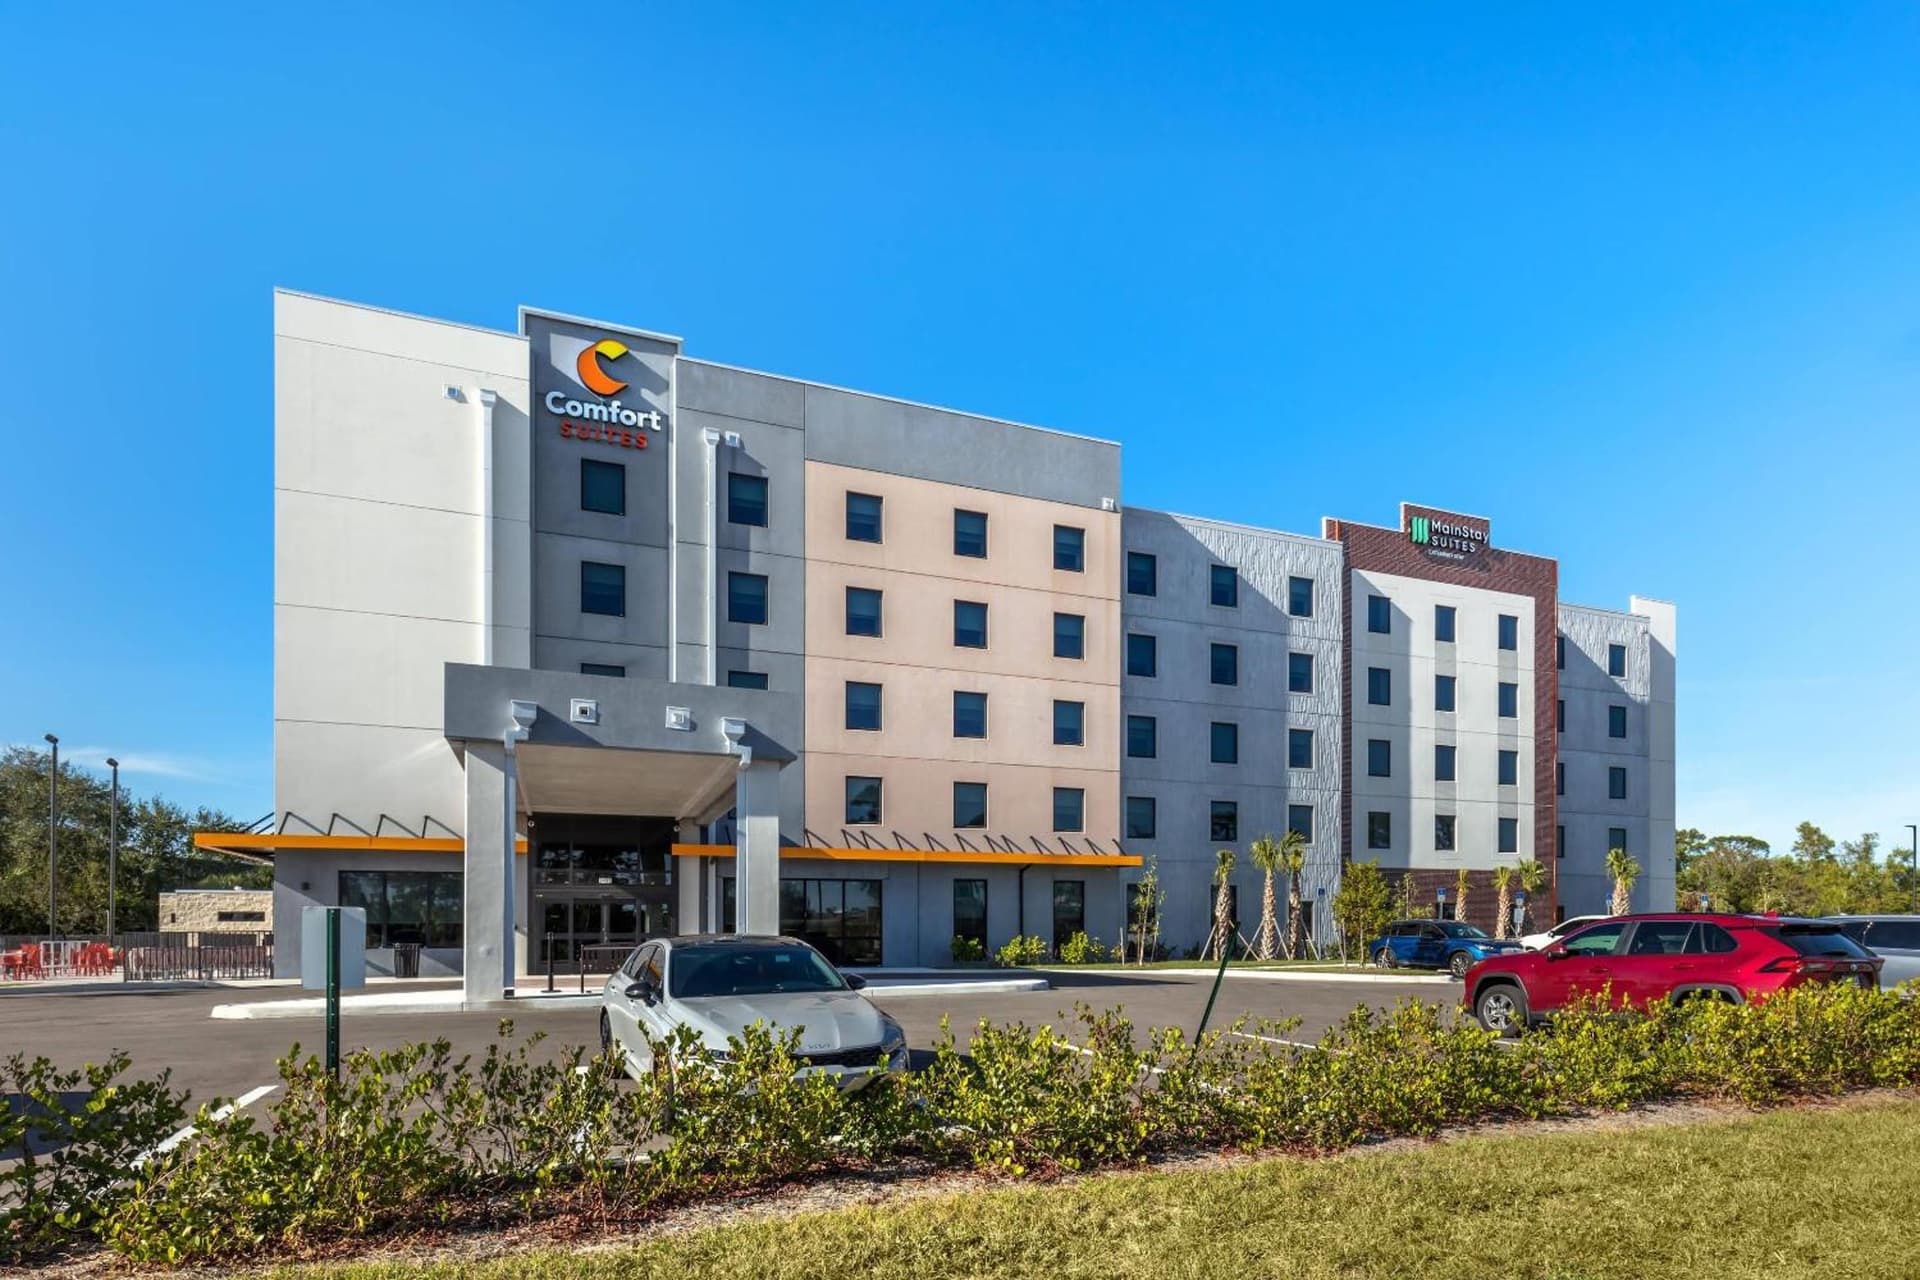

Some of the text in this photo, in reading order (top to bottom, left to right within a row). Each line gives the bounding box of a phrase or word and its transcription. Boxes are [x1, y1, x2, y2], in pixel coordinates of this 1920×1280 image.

[545, 391, 661, 431] Comfort
[560, 418, 648, 449] SUITES
[1431, 519, 1489, 544] MainStay
[1431, 535, 1475, 553] SUITES
